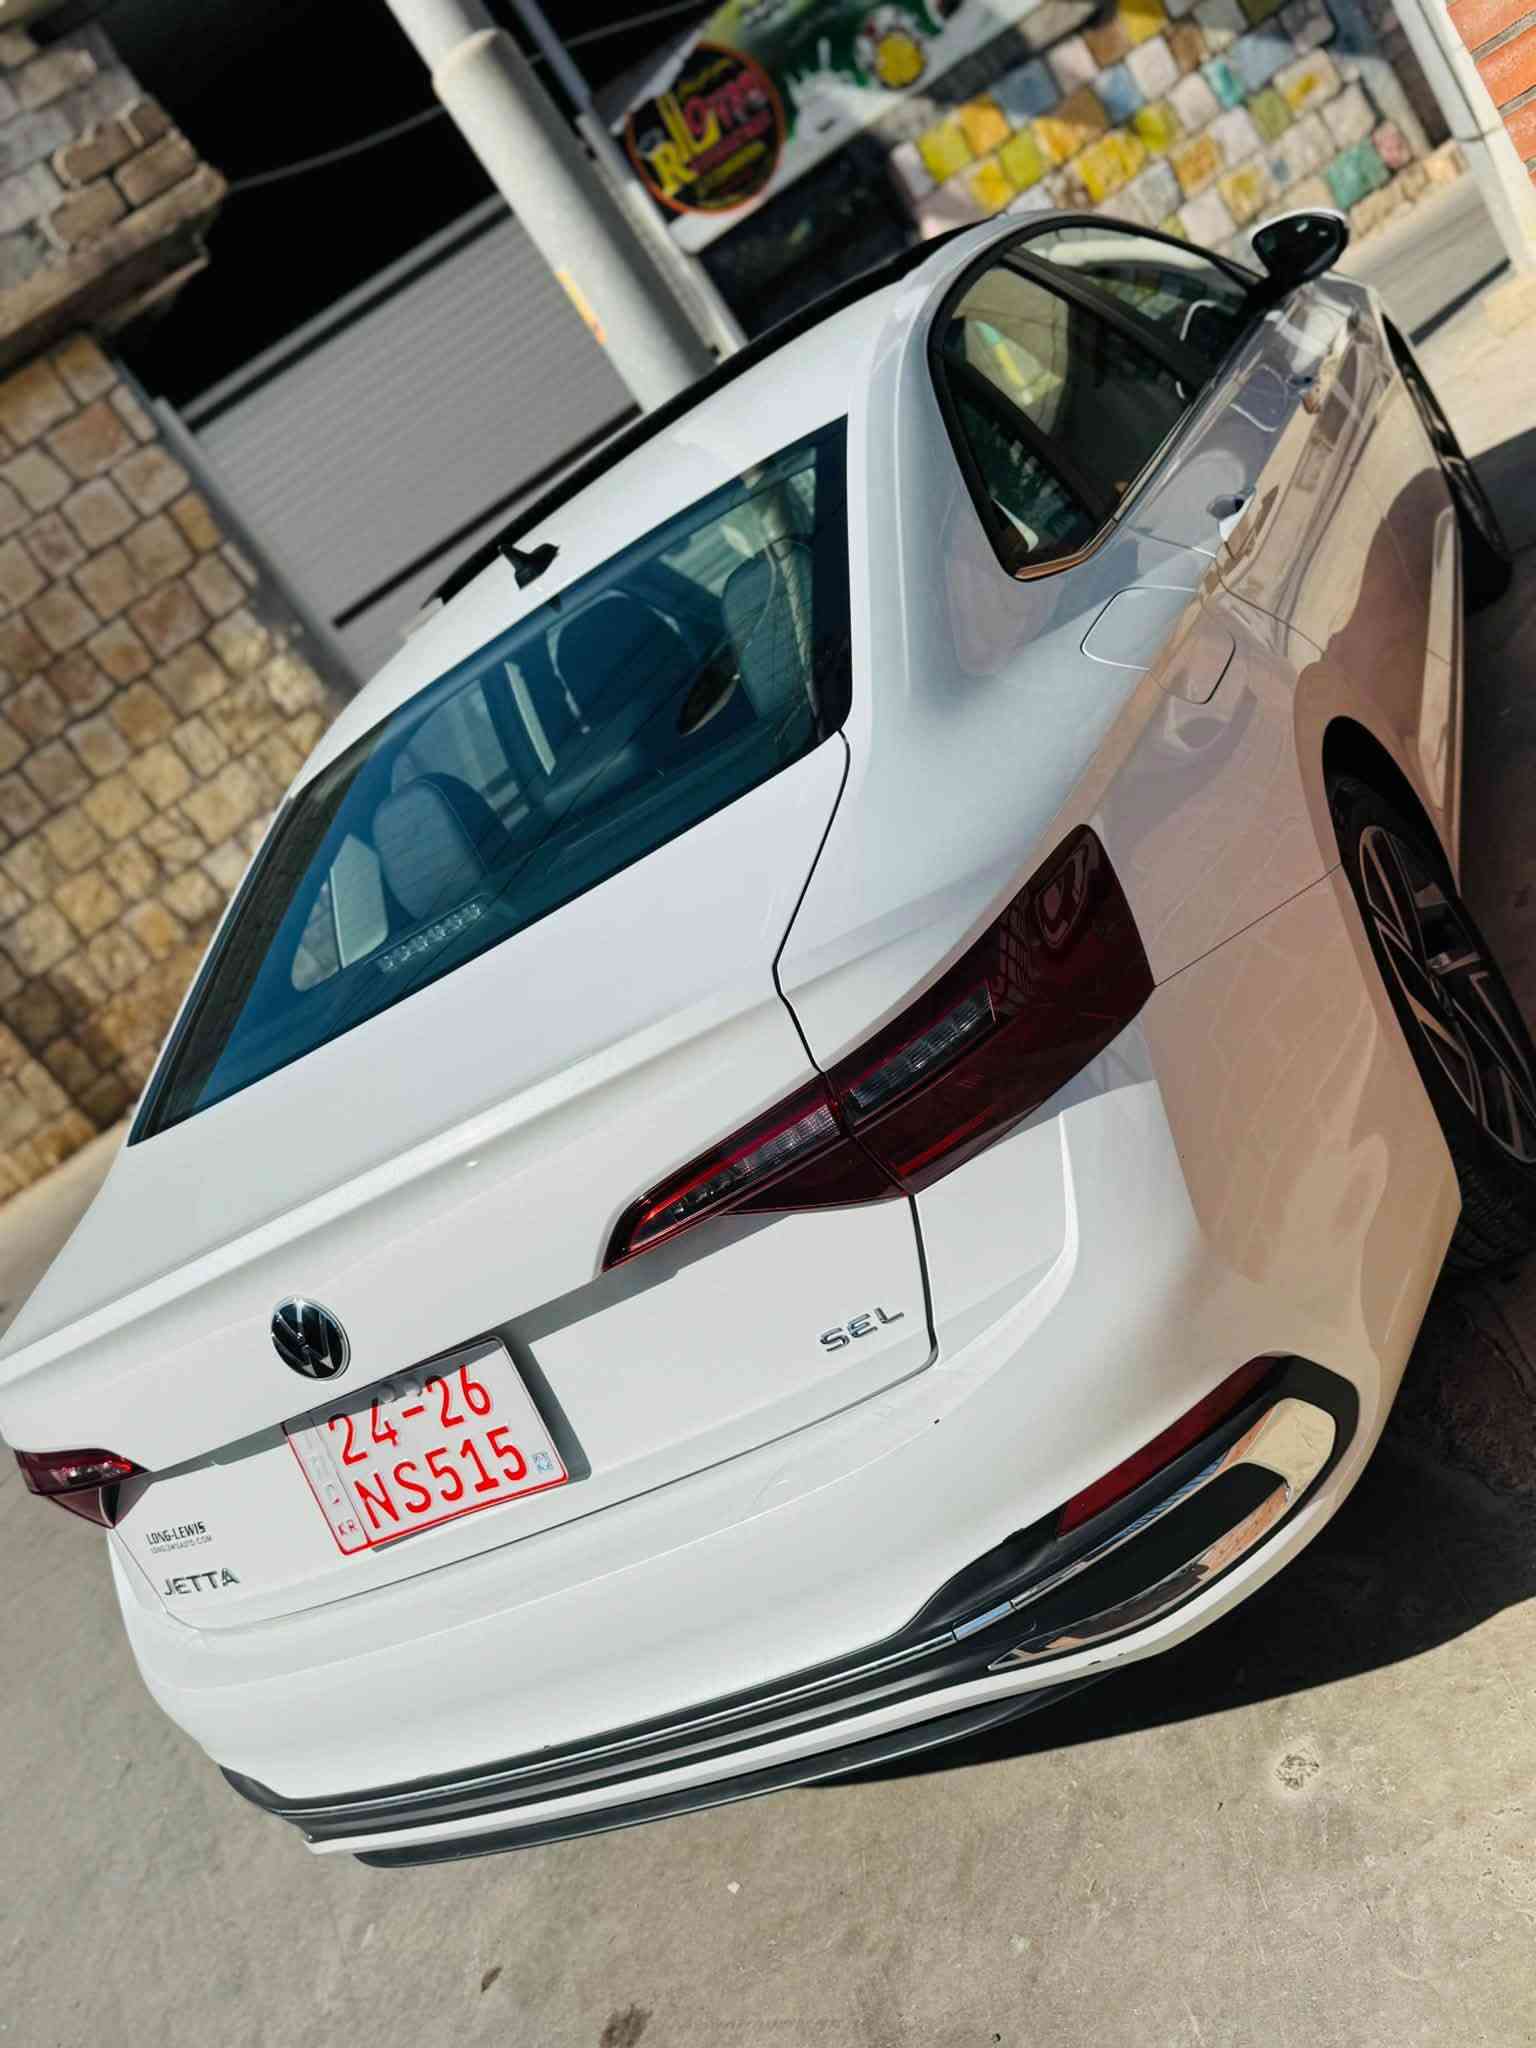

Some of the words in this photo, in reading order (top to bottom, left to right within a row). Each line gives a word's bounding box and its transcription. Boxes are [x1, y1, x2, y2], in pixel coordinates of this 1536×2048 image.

[820, 1307, 904, 1352] SEL
[328, 1364, 491, 1466] 24-26
[354, 1426, 527, 1528] NS515
[146, 1521, 206, 1545] LONG-LEWIS
[164, 1568, 240, 1595] JETTA
